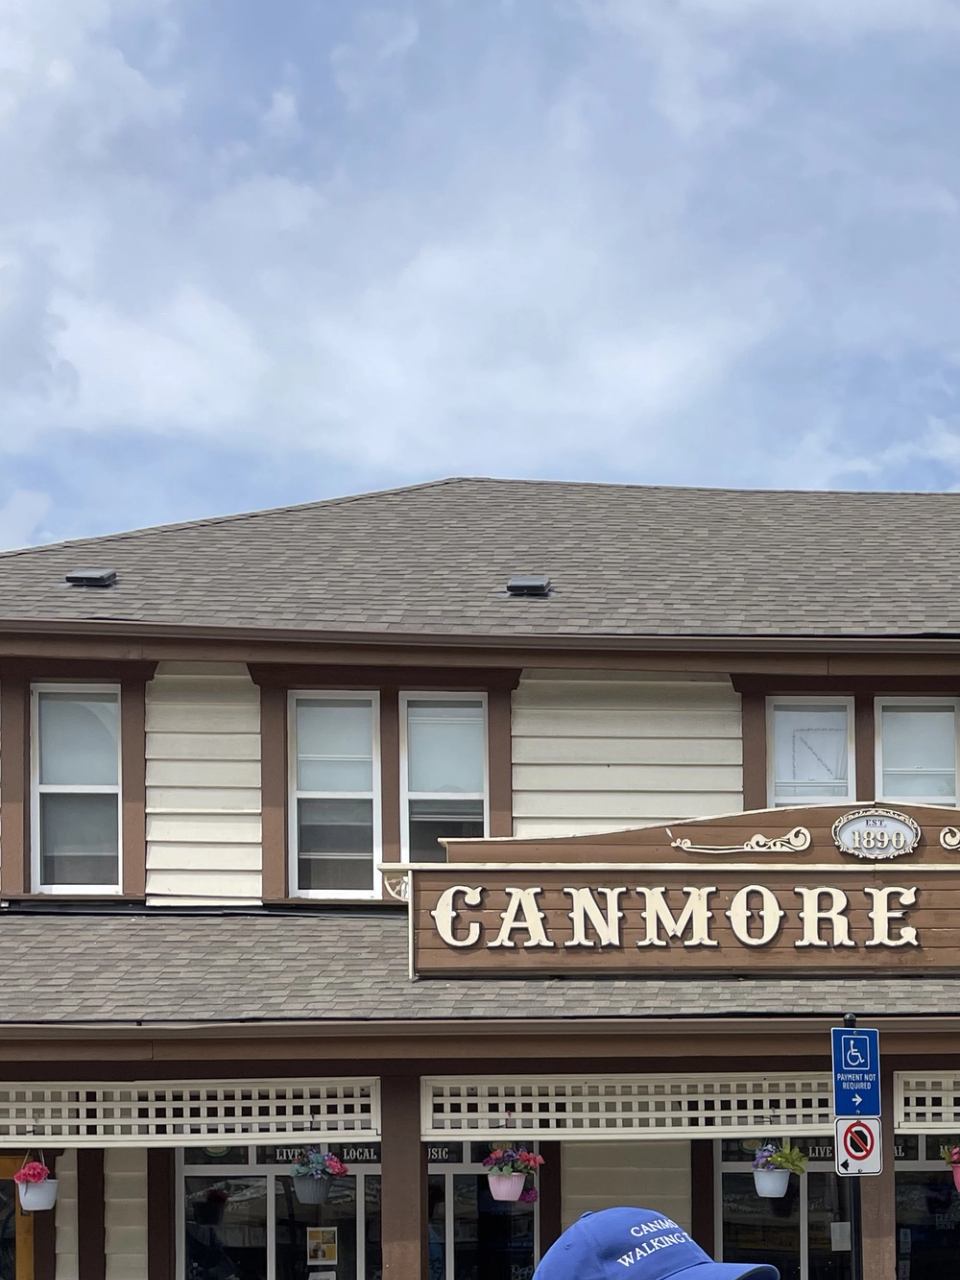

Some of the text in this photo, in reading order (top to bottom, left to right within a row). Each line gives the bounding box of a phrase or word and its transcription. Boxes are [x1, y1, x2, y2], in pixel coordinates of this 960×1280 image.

[852, 830, 905, 850] 1890
[430, 884, 919, 947] CANMORE
[836, 1073, 877, 1081] PAYMENT NOT
[842, 1081, 872, 1090] REQUIRED
[343, 1148, 377, 1160] LOCAL
[809, 1146, 833, 1158] LIVE
[616, 1233, 686, 1267] WALKING
